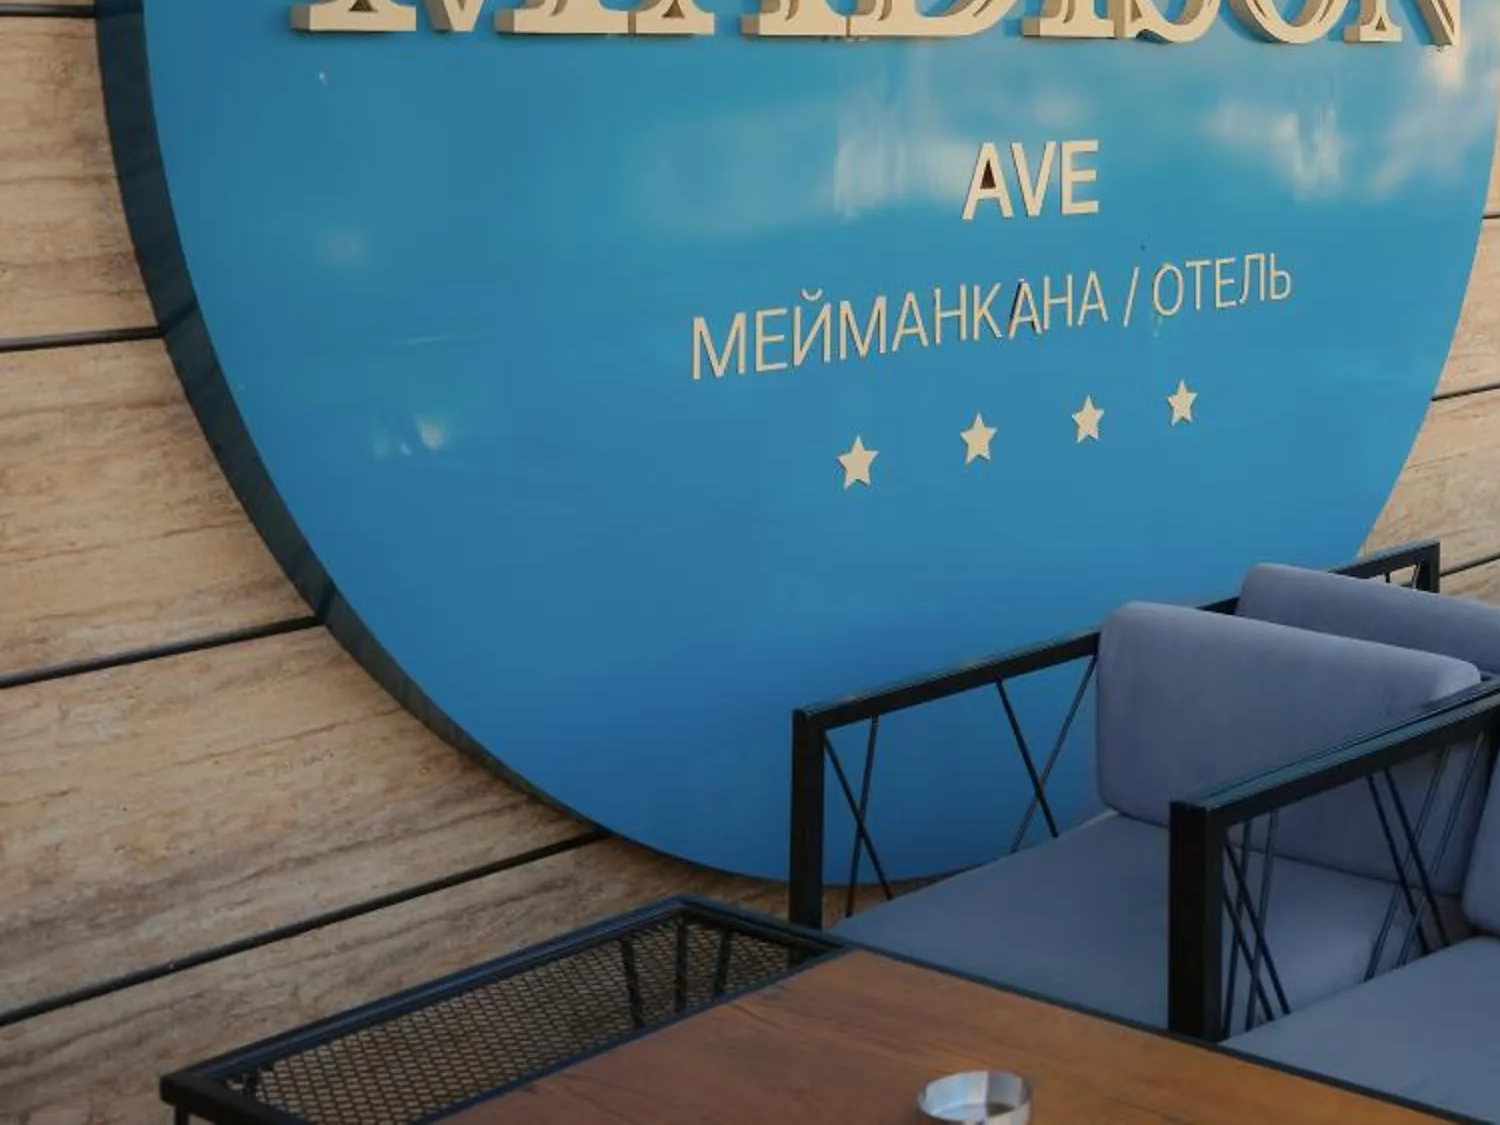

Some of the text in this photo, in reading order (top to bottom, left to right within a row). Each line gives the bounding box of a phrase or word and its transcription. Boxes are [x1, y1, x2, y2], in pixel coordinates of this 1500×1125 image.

[962, 139, 1099, 221] AVE
[691, 270, 1109, 380] МЕЙМАНКАНА
[1151, 252, 1293, 317] ОТЕЛЬ
